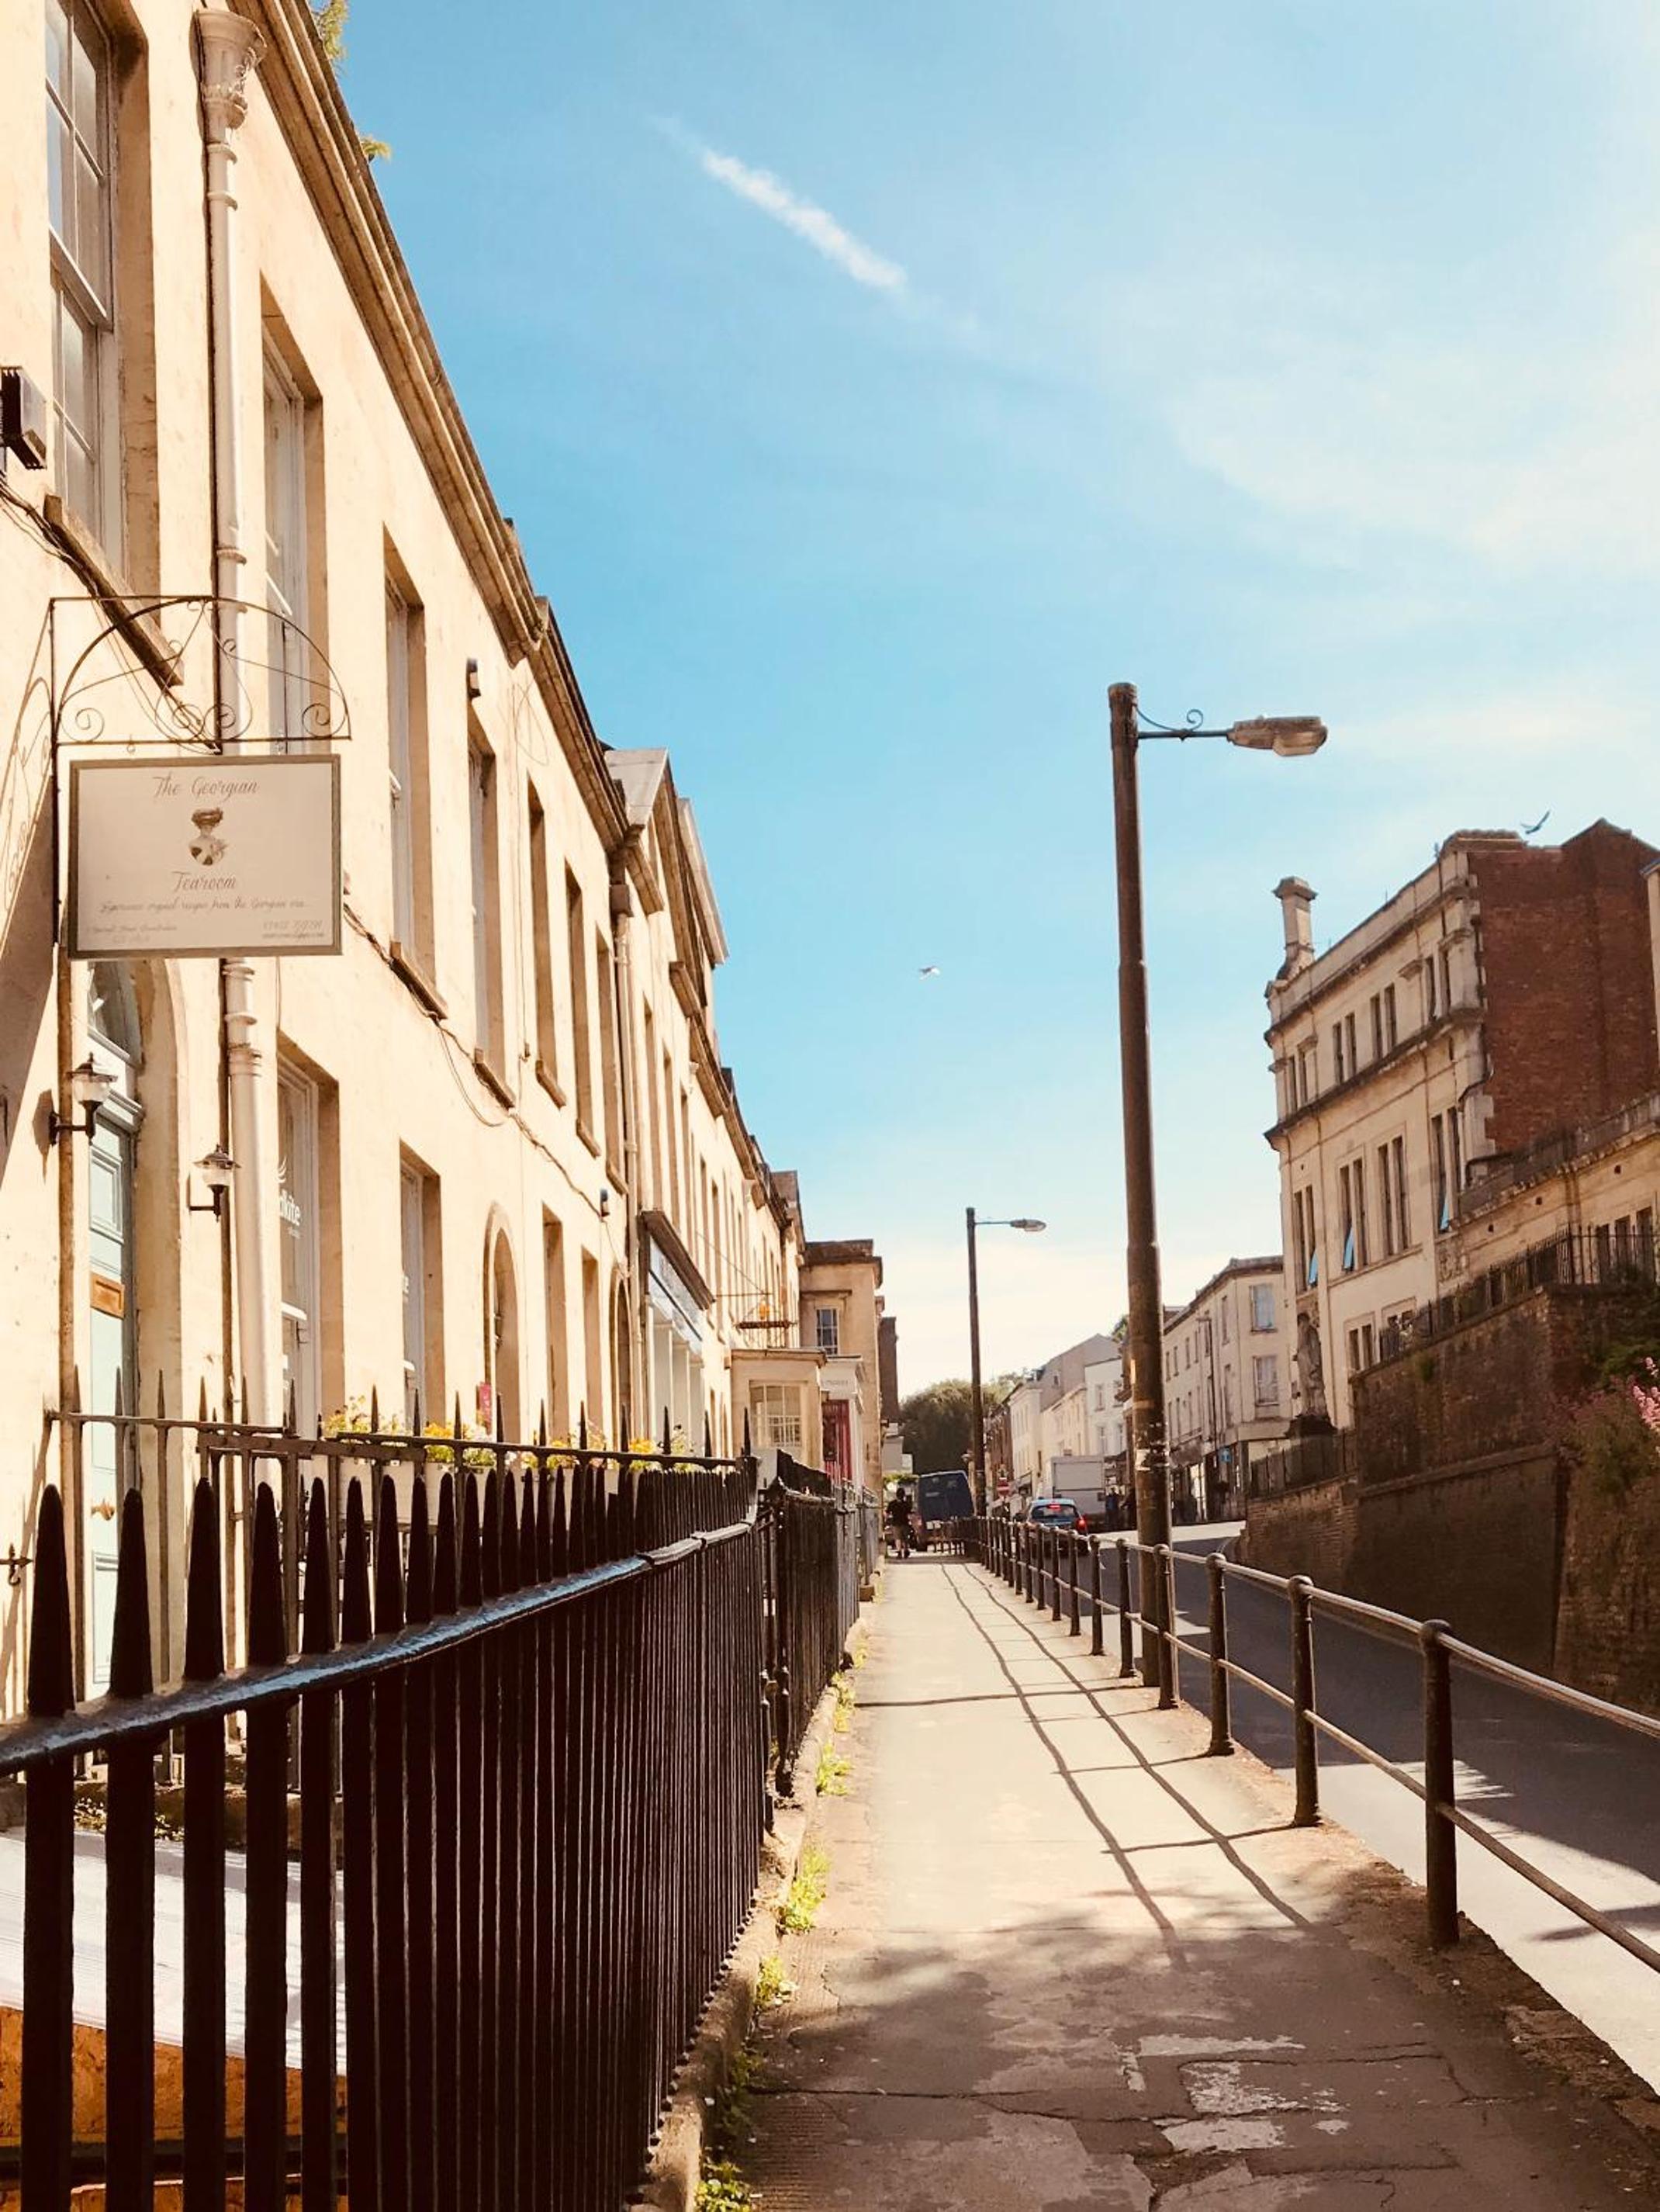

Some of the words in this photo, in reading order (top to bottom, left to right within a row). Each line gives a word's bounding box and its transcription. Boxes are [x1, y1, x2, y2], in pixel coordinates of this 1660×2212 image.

[152, 771, 182, 798] The
[191, 776, 259, 801] Georgian
[172, 871, 237, 892] Tearoom
